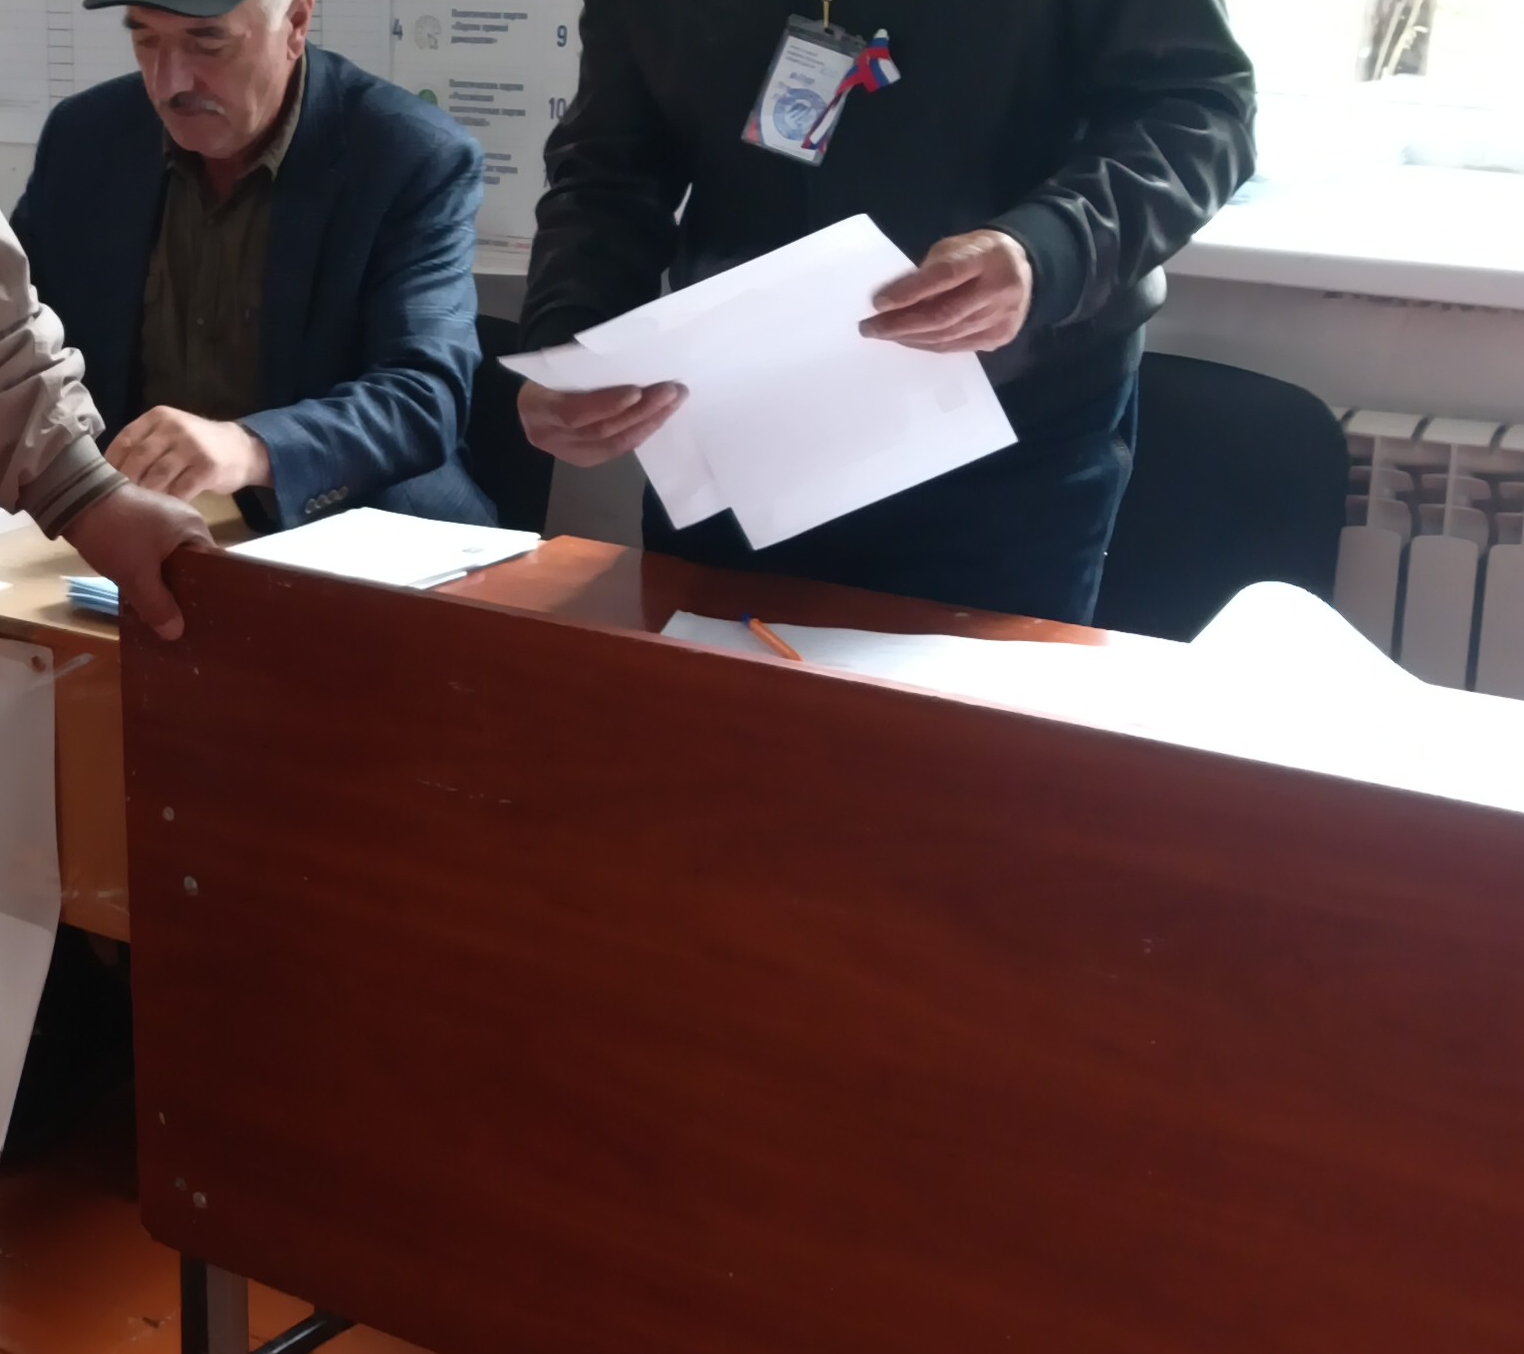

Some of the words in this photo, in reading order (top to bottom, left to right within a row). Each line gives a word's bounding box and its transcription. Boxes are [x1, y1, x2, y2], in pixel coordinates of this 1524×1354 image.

[392, 18, 404, 41] 4
[556, 25, 568, 47] 9
[548, 97, 568, 120] 10
